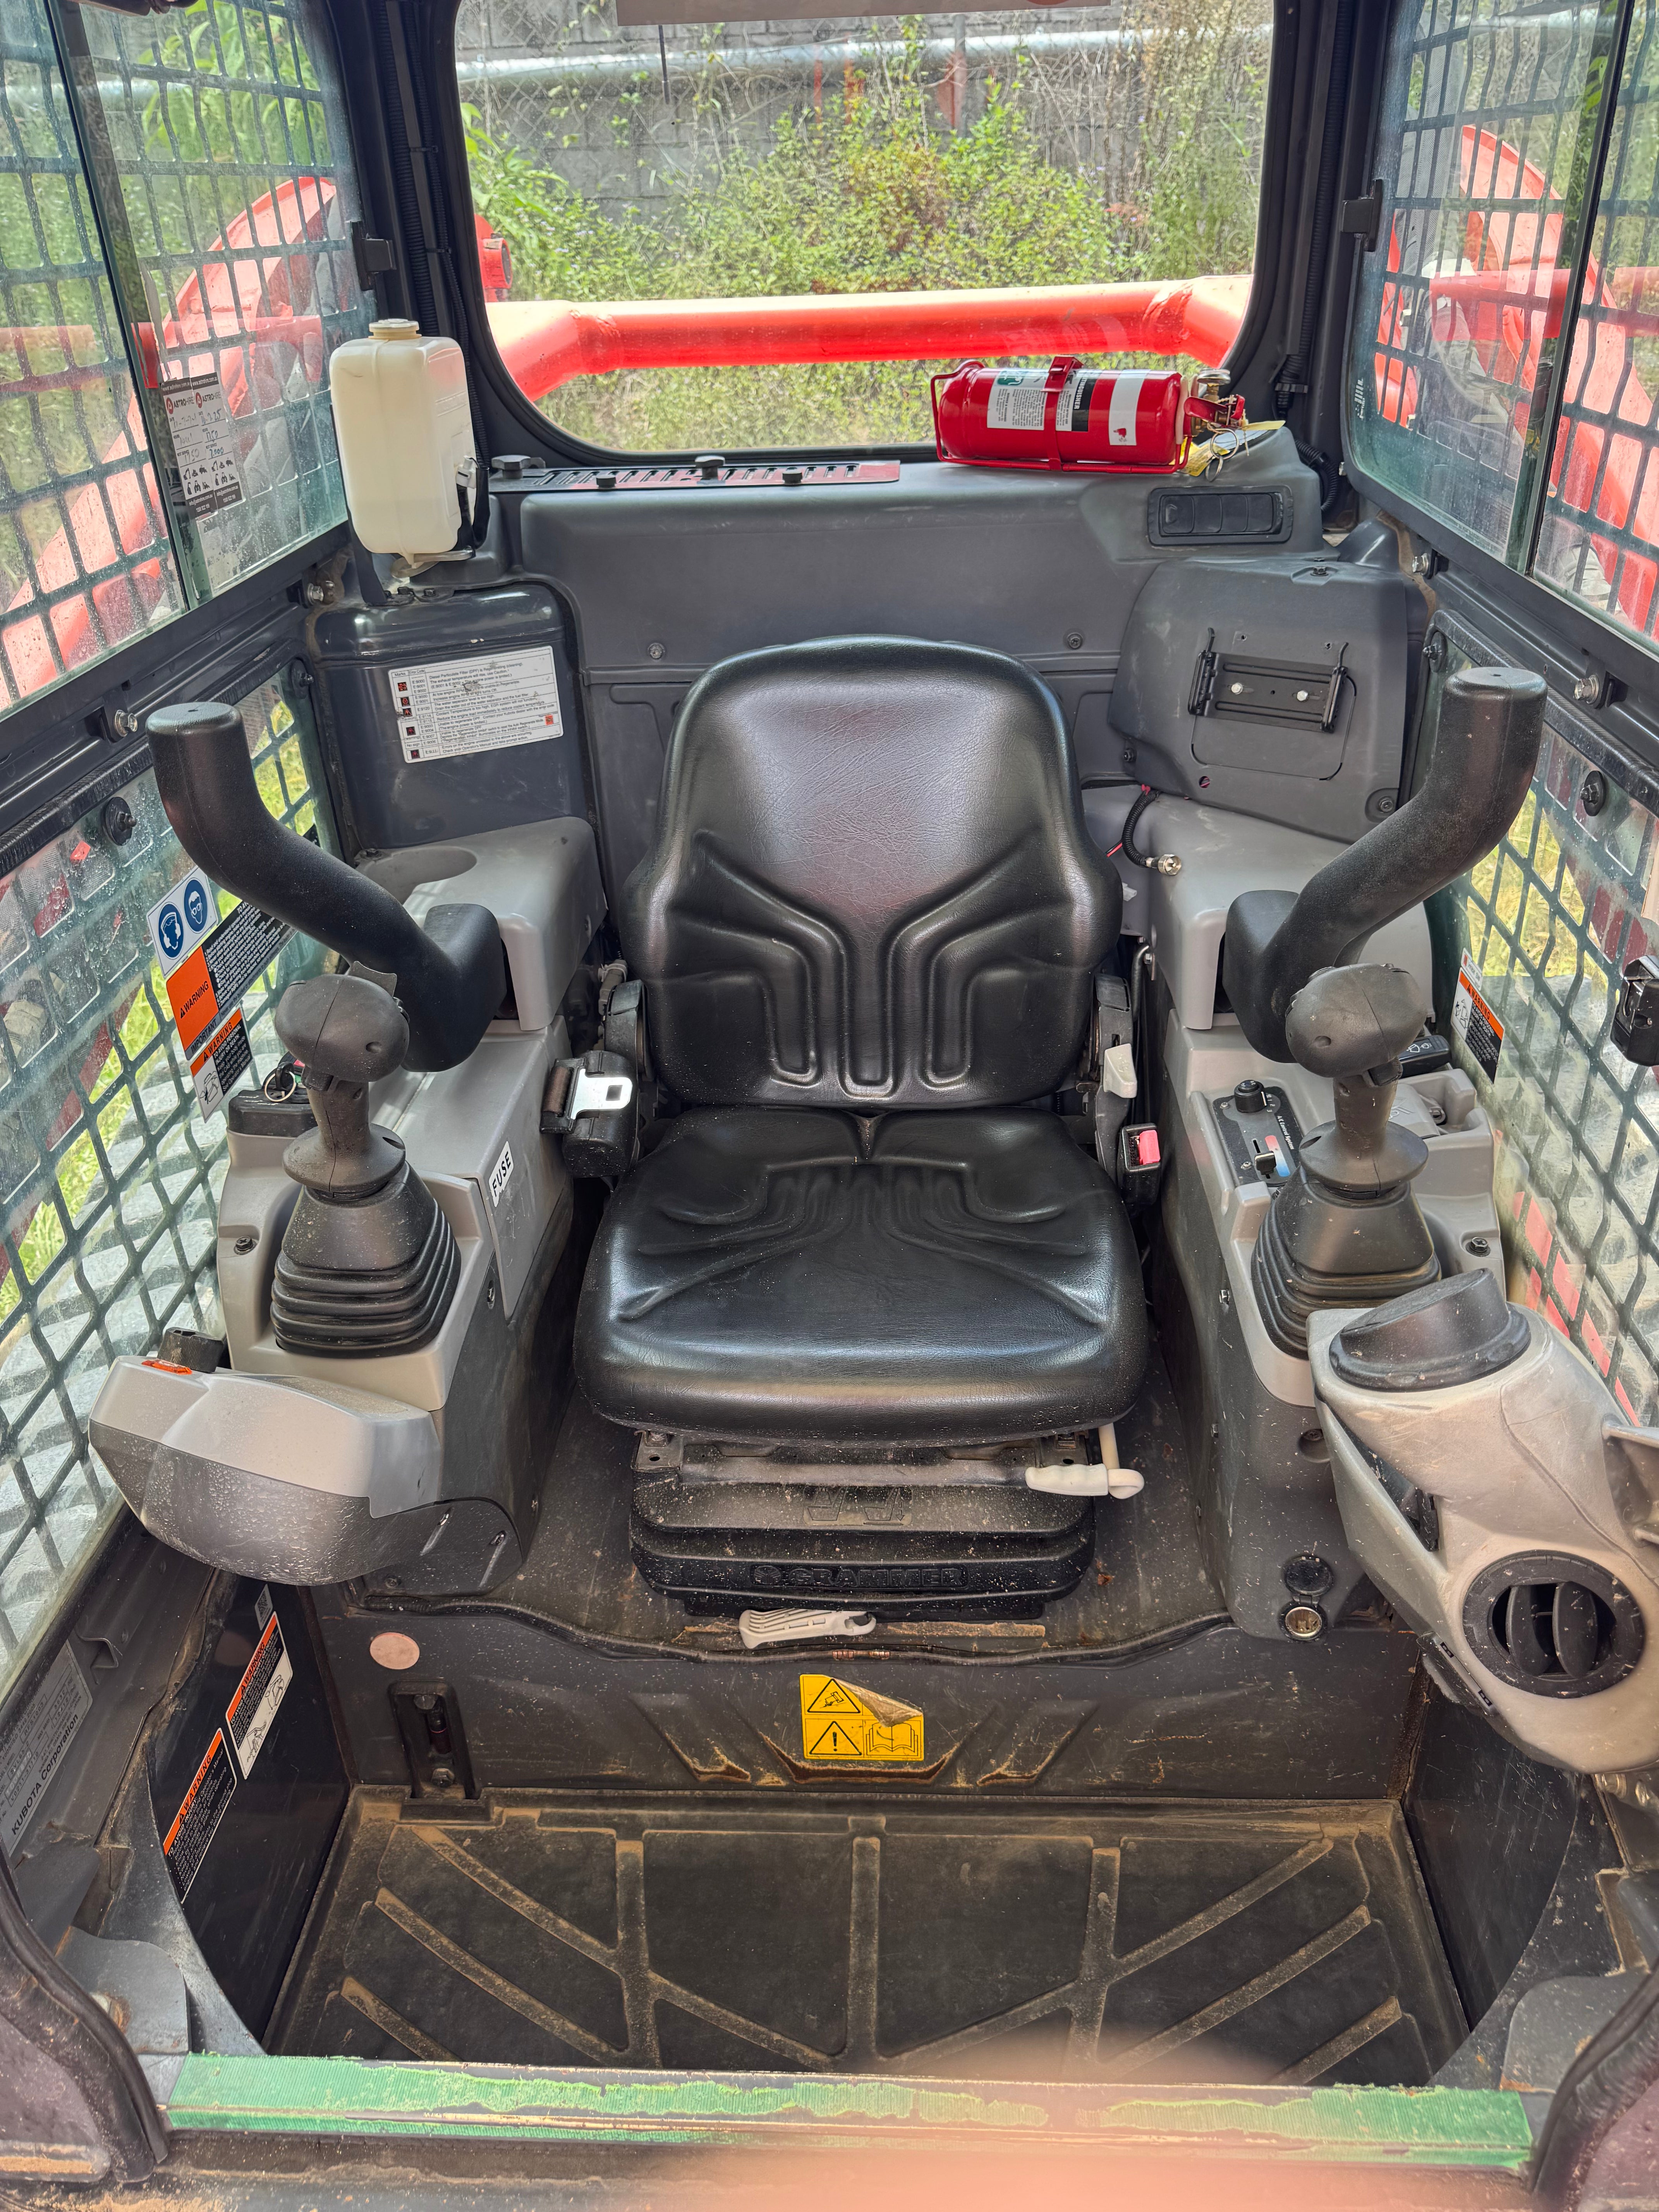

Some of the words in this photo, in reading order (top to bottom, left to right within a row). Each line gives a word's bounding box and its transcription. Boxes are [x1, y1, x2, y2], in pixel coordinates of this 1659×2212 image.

[184, 981, 209, 1013] WARNING
[1471, 988, 1490, 1020] WARNING
[191, 1018, 217, 1054] IMPORTANT
[208, 1021, 232, 1055] WARNING
[1280, 1122, 1290, 1135] Control
[1285, 1135, 1295, 1150] System
[491, 1151, 512, 1197] FUSE
[788, 1568, 962, 1587] GRAMMER
[244, 1640, 265, 1686] WARNING
[11, 1782, 42, 1835] KUBOTA
[41, 1714, 79, 1781] Corporation
[184, 1753, 211, 1813] WARNING
[168, 1846, 173, 1858] TO
[173, 1822, 185, 1846] AVOID
[184, 1795, 198, 1823] INJURY:
